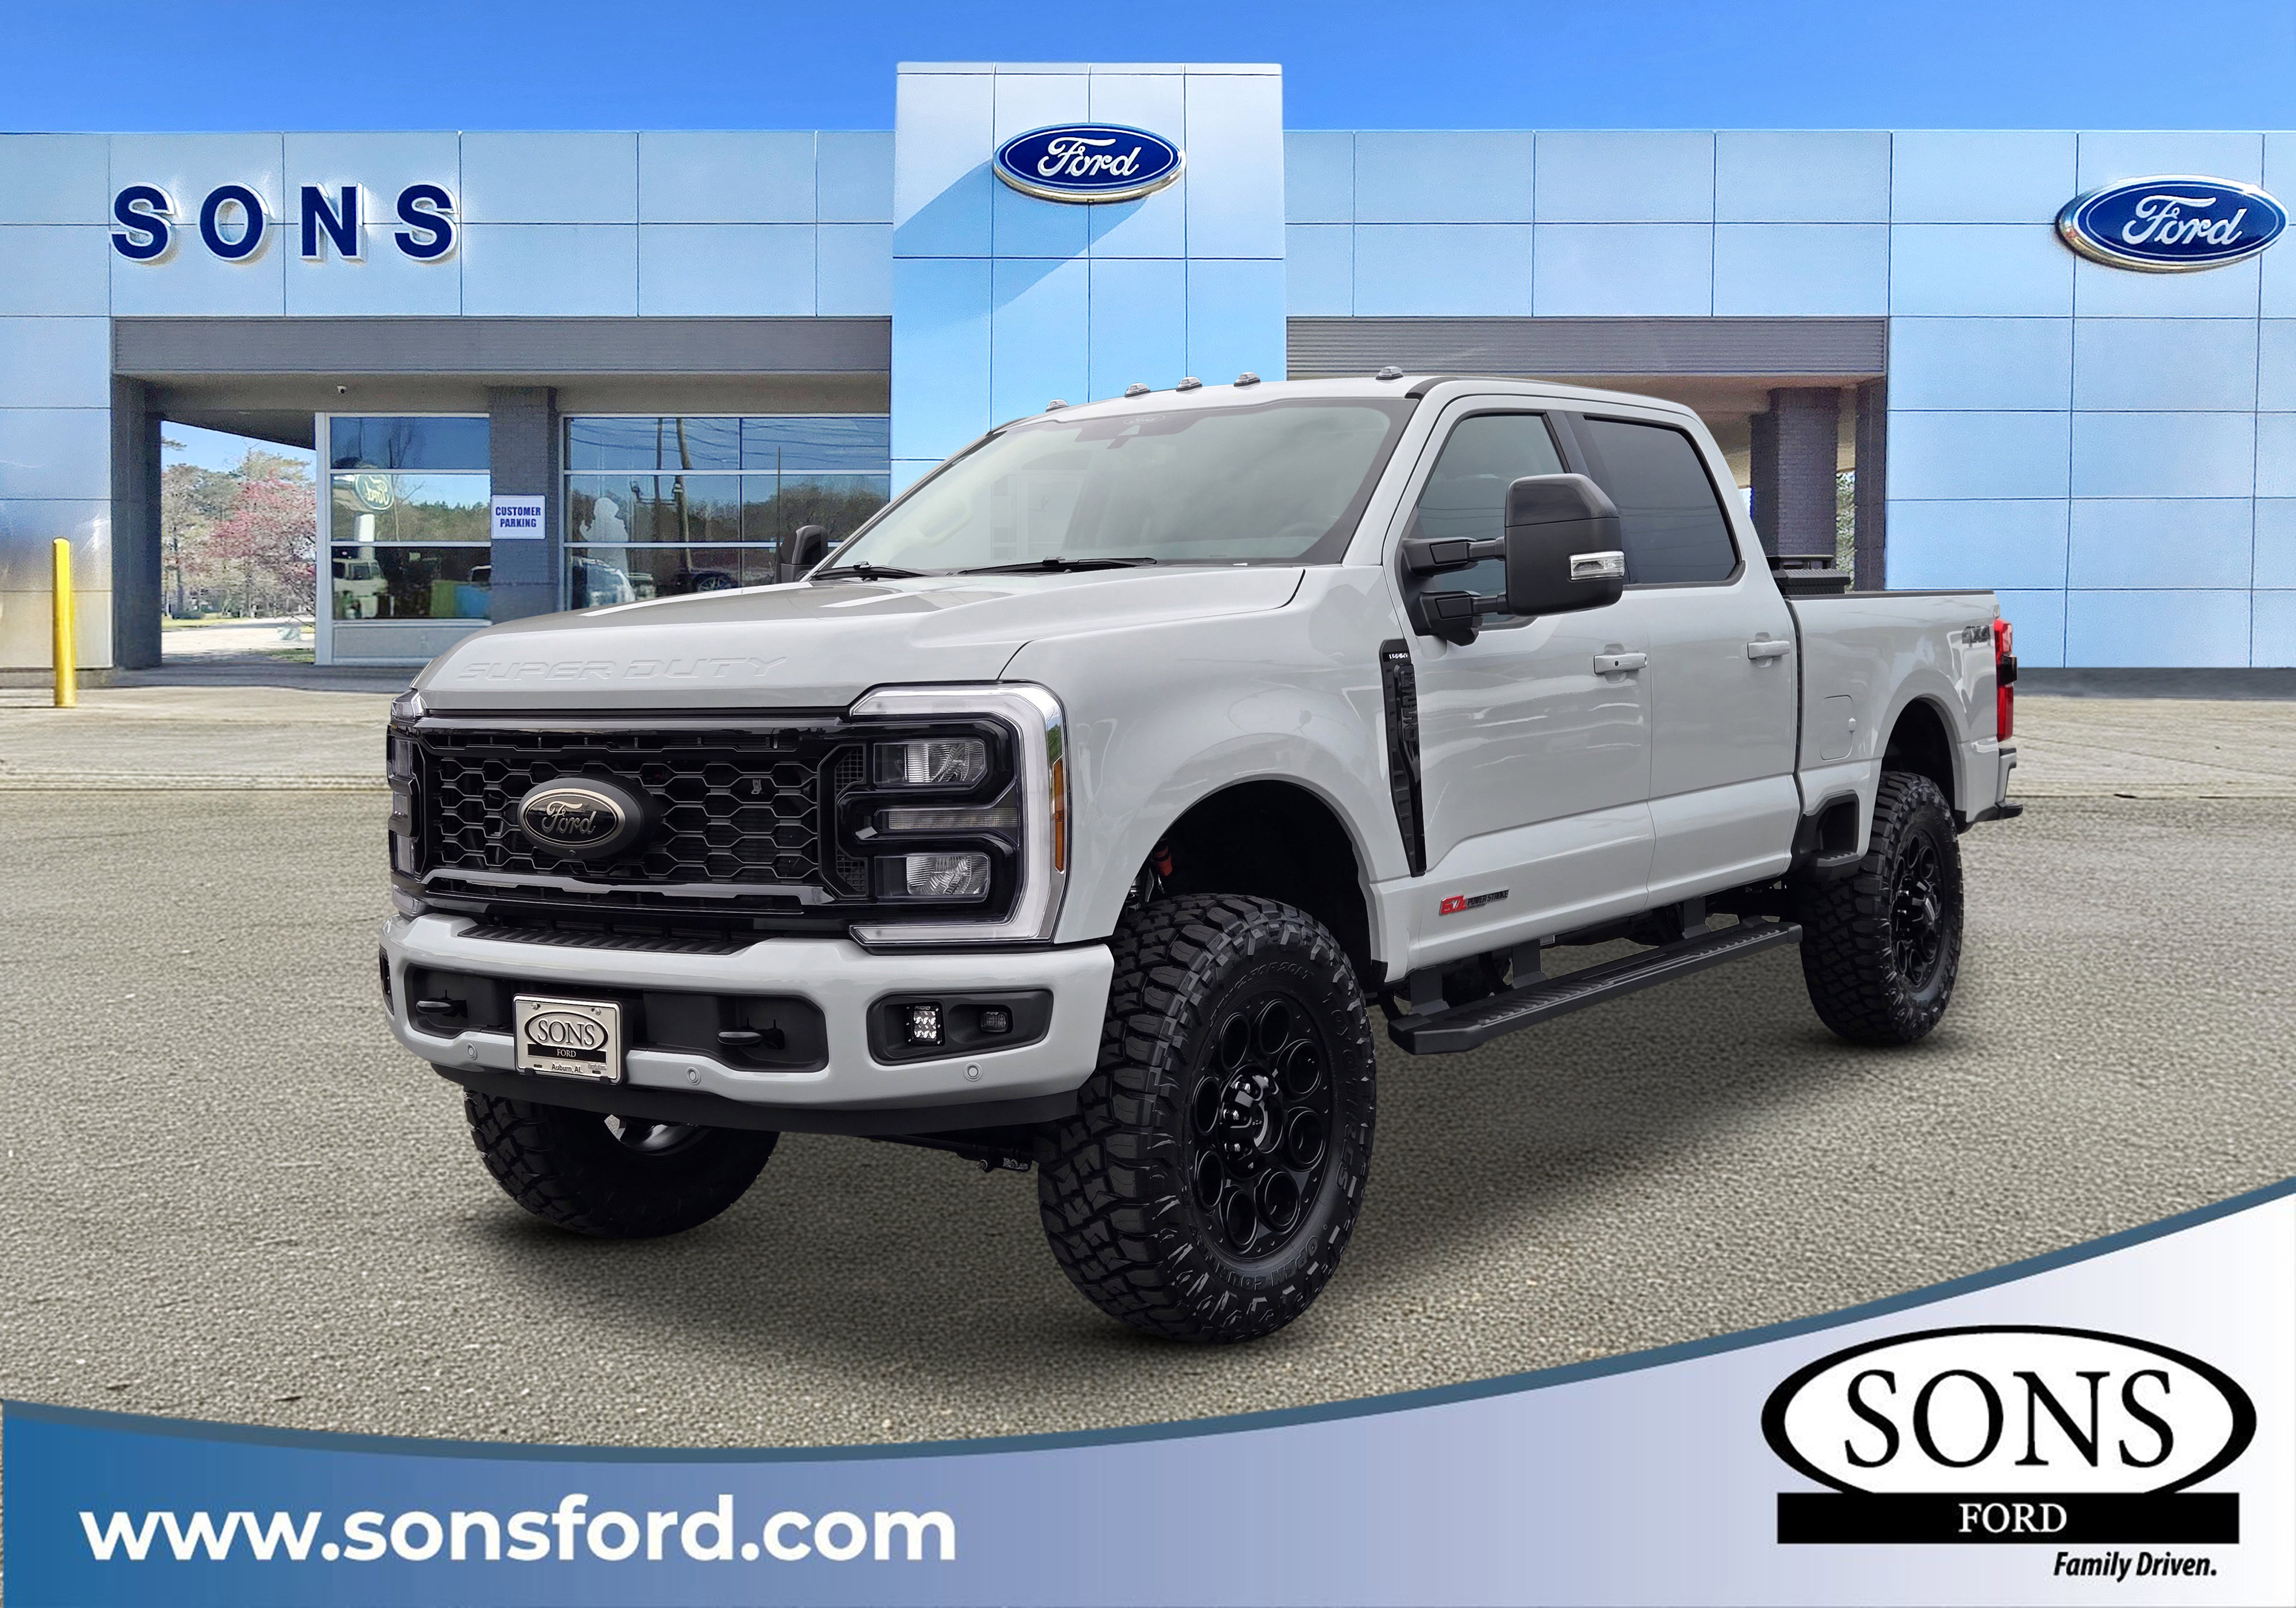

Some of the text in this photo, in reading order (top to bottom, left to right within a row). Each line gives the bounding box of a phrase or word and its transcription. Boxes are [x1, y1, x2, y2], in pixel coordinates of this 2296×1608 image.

[1037, 137, 1142, 177] Ford
[111, 182, 459, 263] SONS
[2122, 195, 2247, 246] Ford
[495, 506, 541, 516] CUSTOMER
[500, 518, 537, 527] PARKING
[455, 656, 788, 682] SUPER DUTY
[541, 801, 598, 834] Ford
[537, 1020, 595, 1047] SONS
[557, 1048, 576, 1058] FORD
[551, 1064, 573, 1073] Auburn,
[575, 1065, 583, 1073] AL
